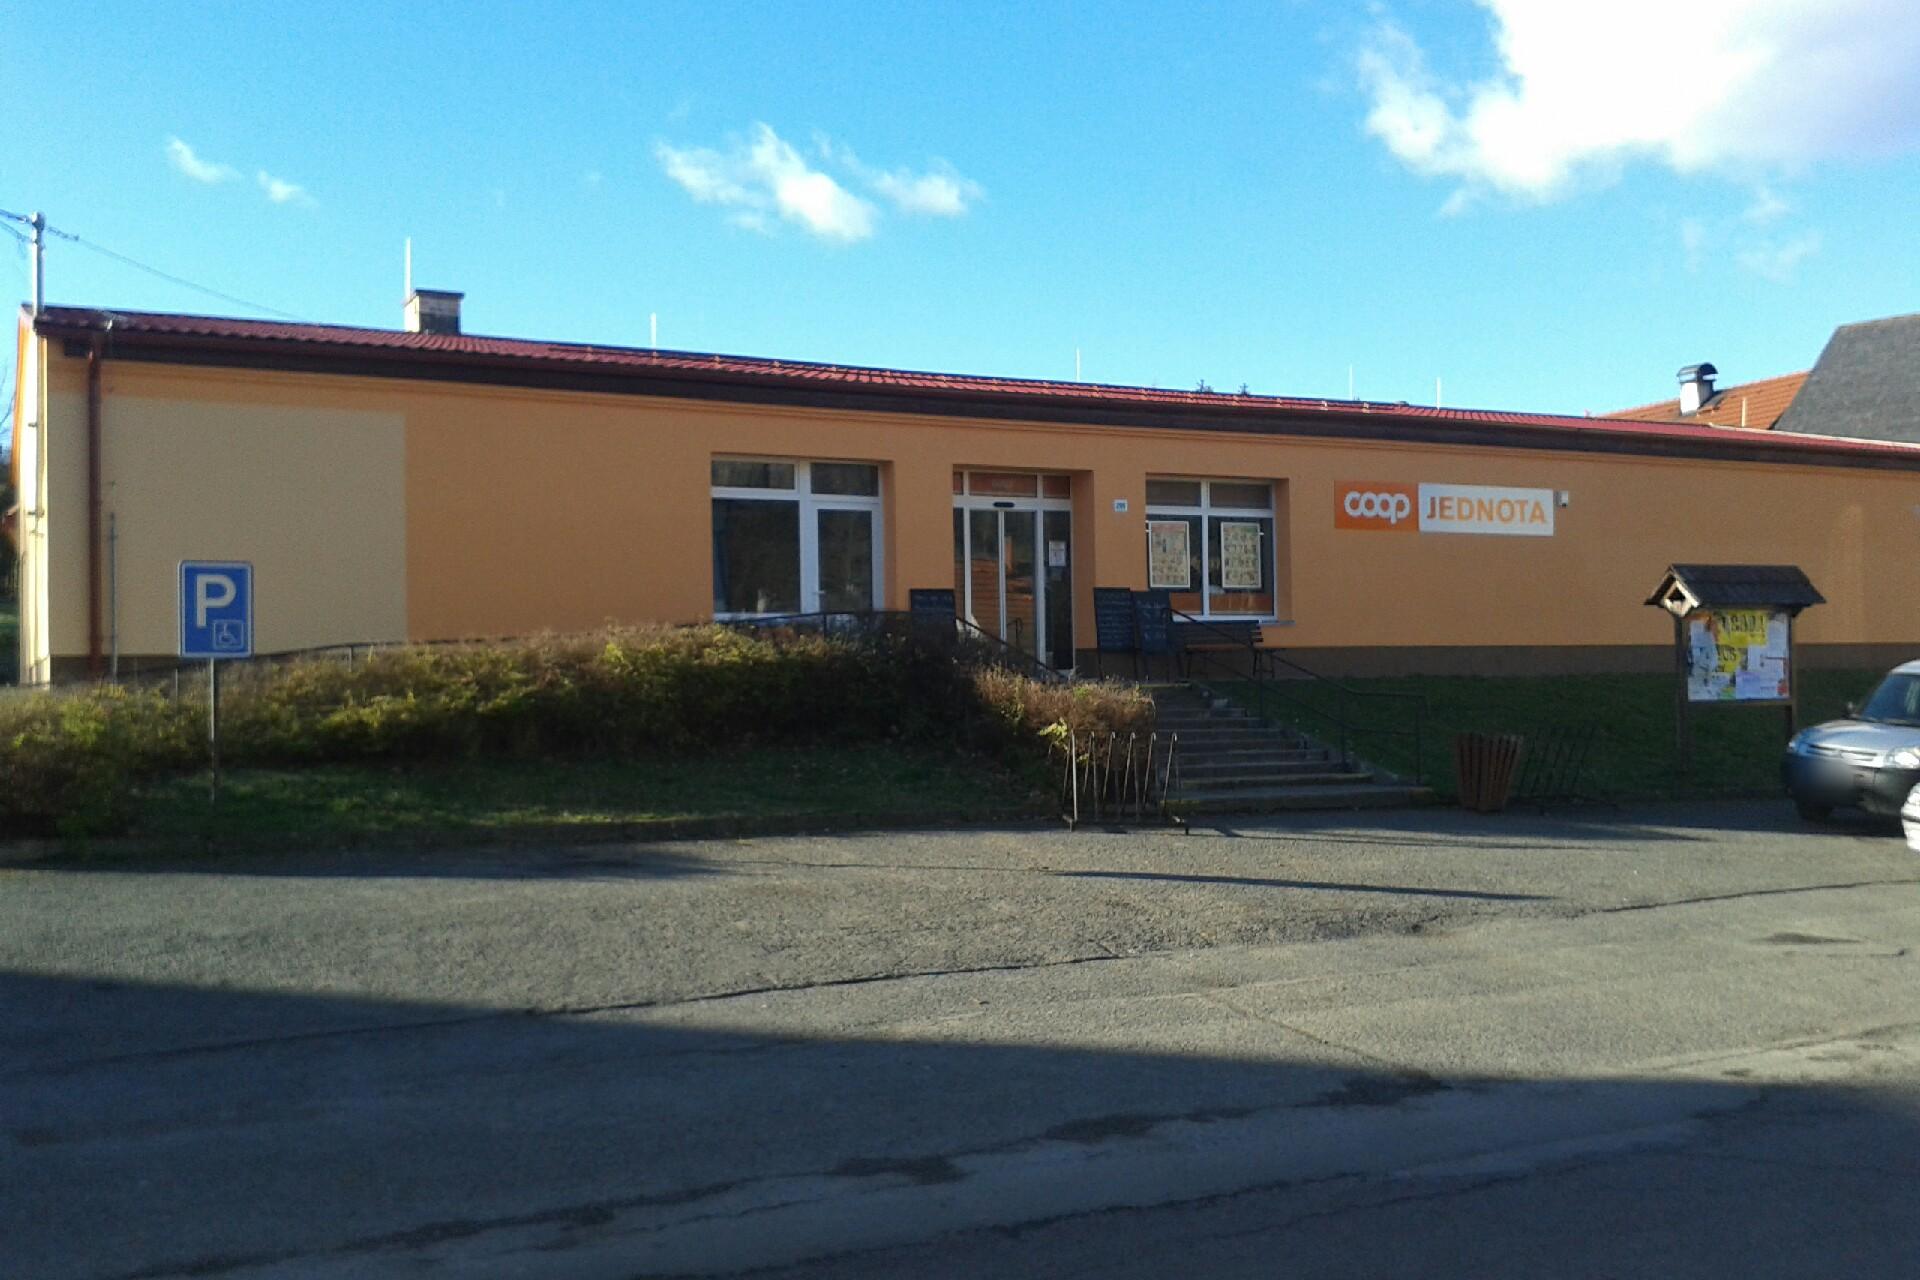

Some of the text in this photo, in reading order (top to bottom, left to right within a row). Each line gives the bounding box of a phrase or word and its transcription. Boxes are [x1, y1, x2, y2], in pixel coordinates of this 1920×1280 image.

[1344, 491, 1546, 524] coop JEDNOTA
[196, 573, 236, 628] P
